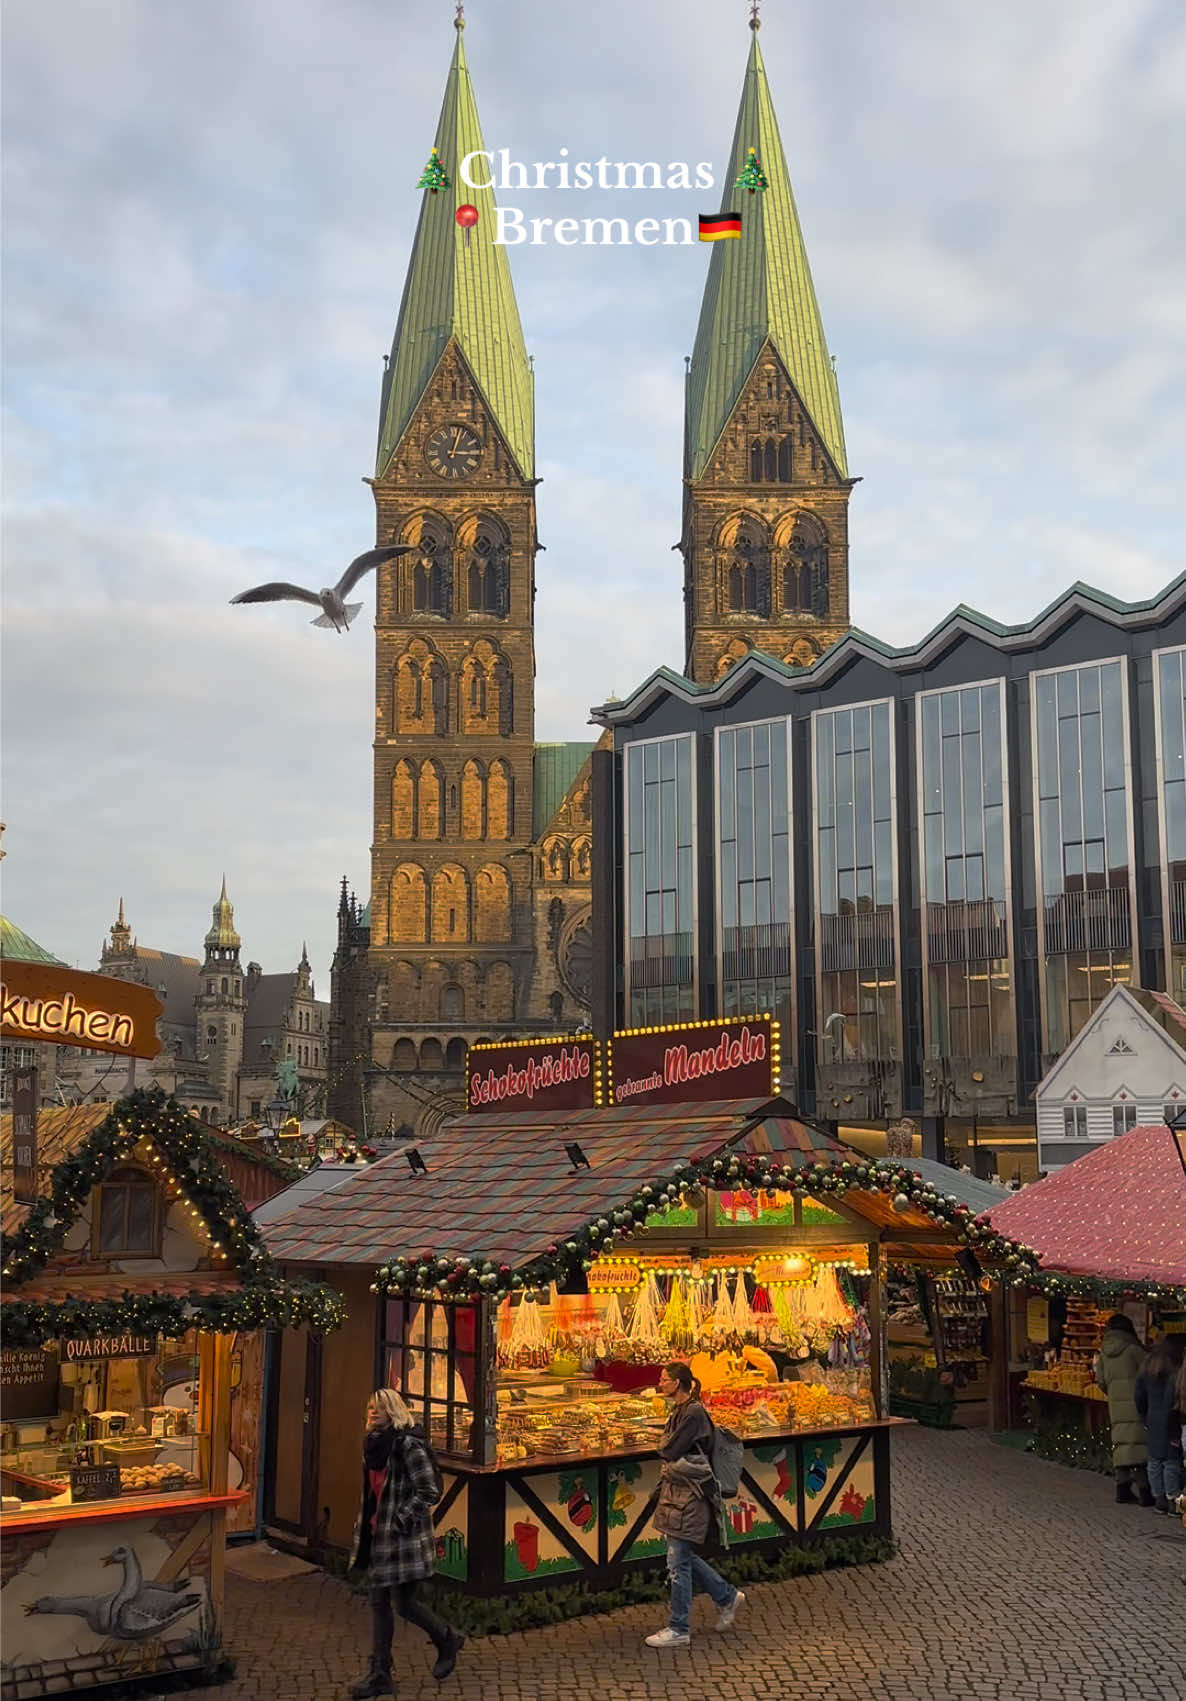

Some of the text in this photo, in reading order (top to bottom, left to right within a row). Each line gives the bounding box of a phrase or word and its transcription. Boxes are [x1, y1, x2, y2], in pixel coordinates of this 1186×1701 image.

[469, 1047, 591, 1105] Schokofrüchte
[664, 1026, 766, 1086] Mandeln
[66, 1335, 151, 1361] QUARKBÄLLE
